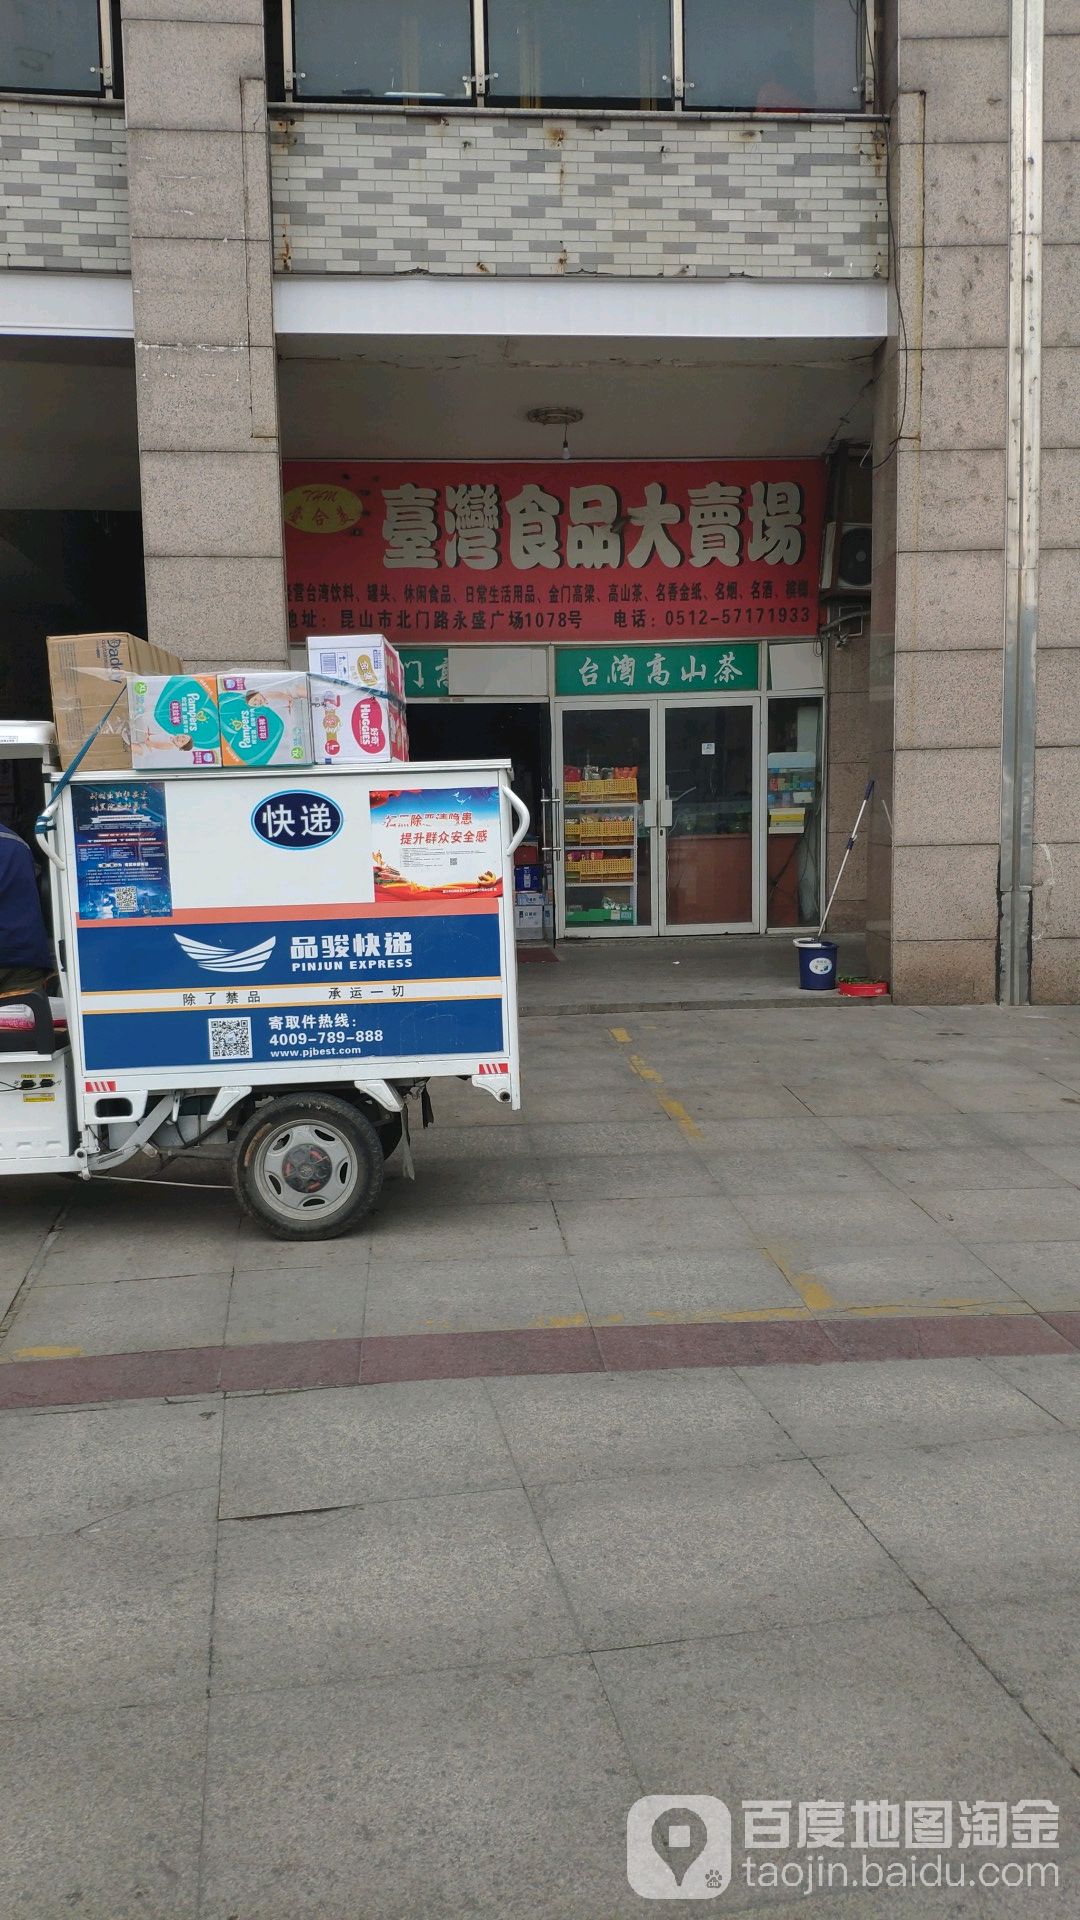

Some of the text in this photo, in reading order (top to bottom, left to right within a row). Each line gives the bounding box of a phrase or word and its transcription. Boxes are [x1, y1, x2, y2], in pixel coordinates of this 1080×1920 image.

[381, 481, 802, 570] 臺灣食品大賣場
[578, 651, 743, 687] 台湾高山茶
[187, 693, 199, 731] Pampers
[239, 710, 252, 748] Pampers
[262, 802, 334, 838] 快递
[400, 829, 488, 846] 提升群众安全感
[290, 931, 413, 960] 品骏快递
[292, 958, 413, 972] PINJUN EXPRESS
[182, 984, 405, 1006] 除了禁品 承运一切
[269, 1029, 384, 1046] 4009-789-888
[270, 1046, 362, 1058] www.pjbest.com
